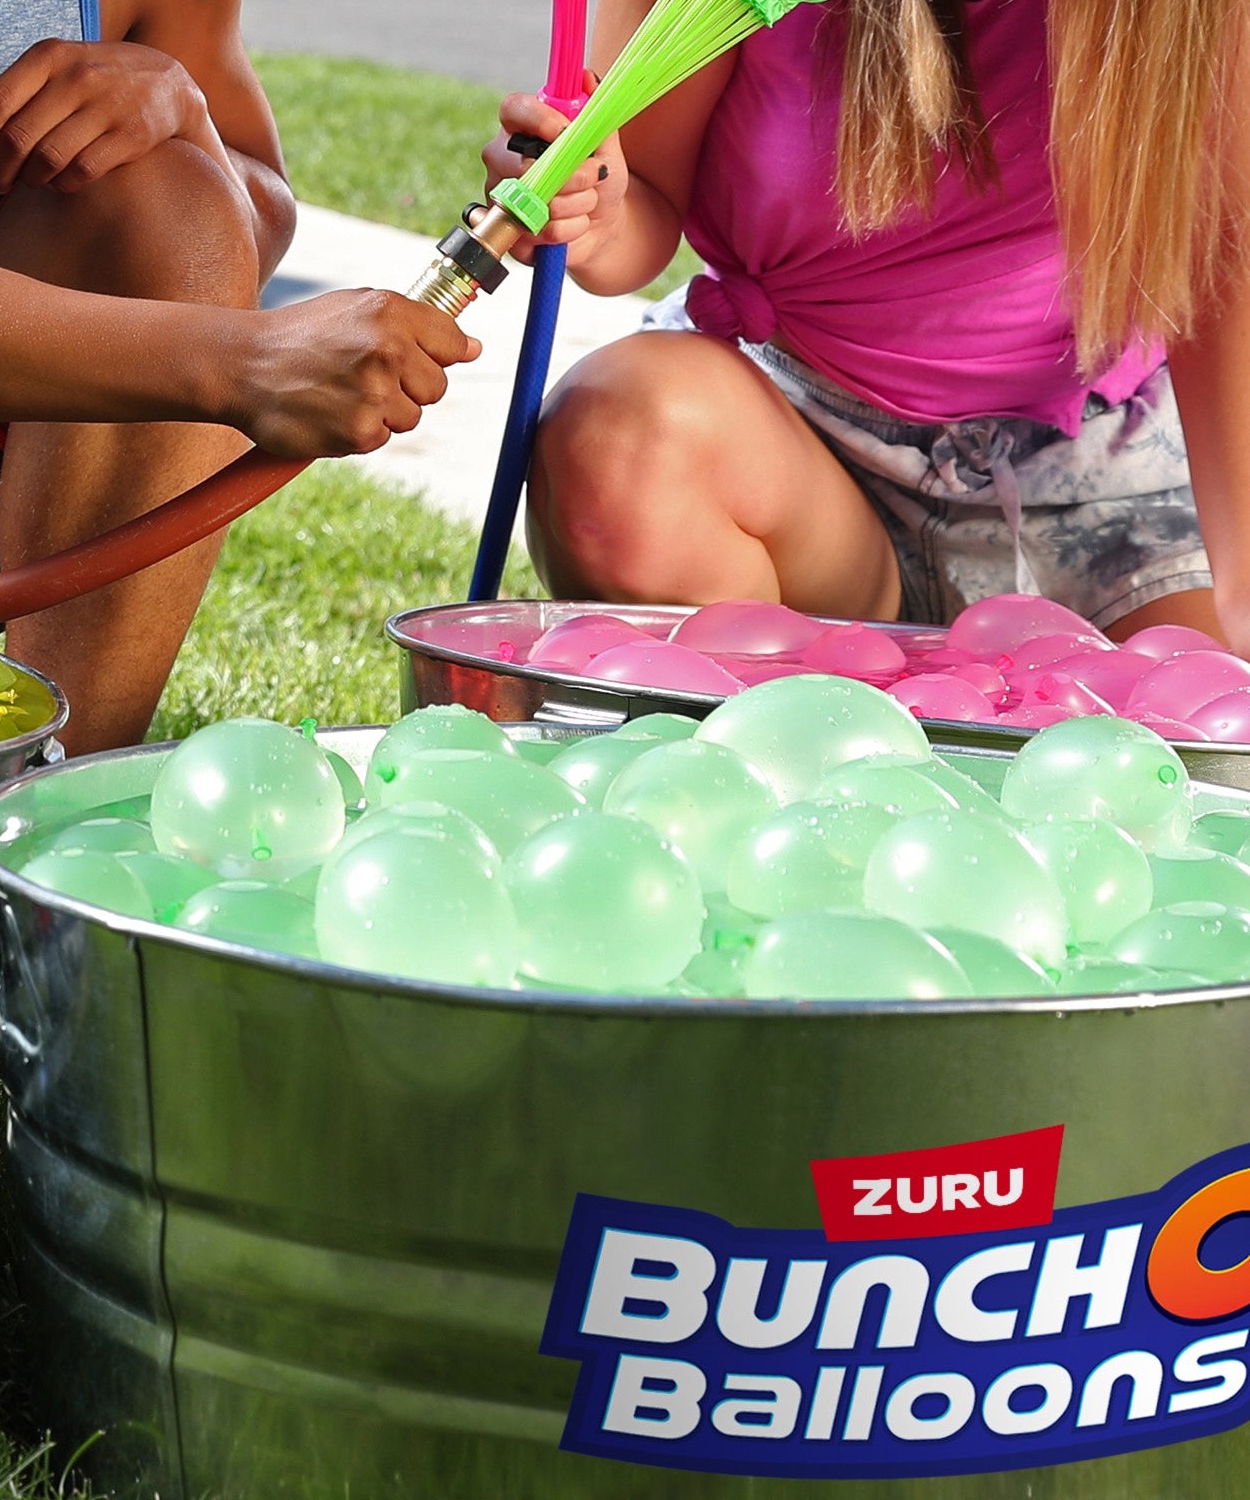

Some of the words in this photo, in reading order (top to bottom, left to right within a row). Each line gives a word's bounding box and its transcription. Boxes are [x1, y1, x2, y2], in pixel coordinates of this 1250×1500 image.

[852, 1167, 1024, 1217] ZURU
[578, 1222, 1144, 1350] BUNCH
[601, 1328, 1250, 1442] Balloons
